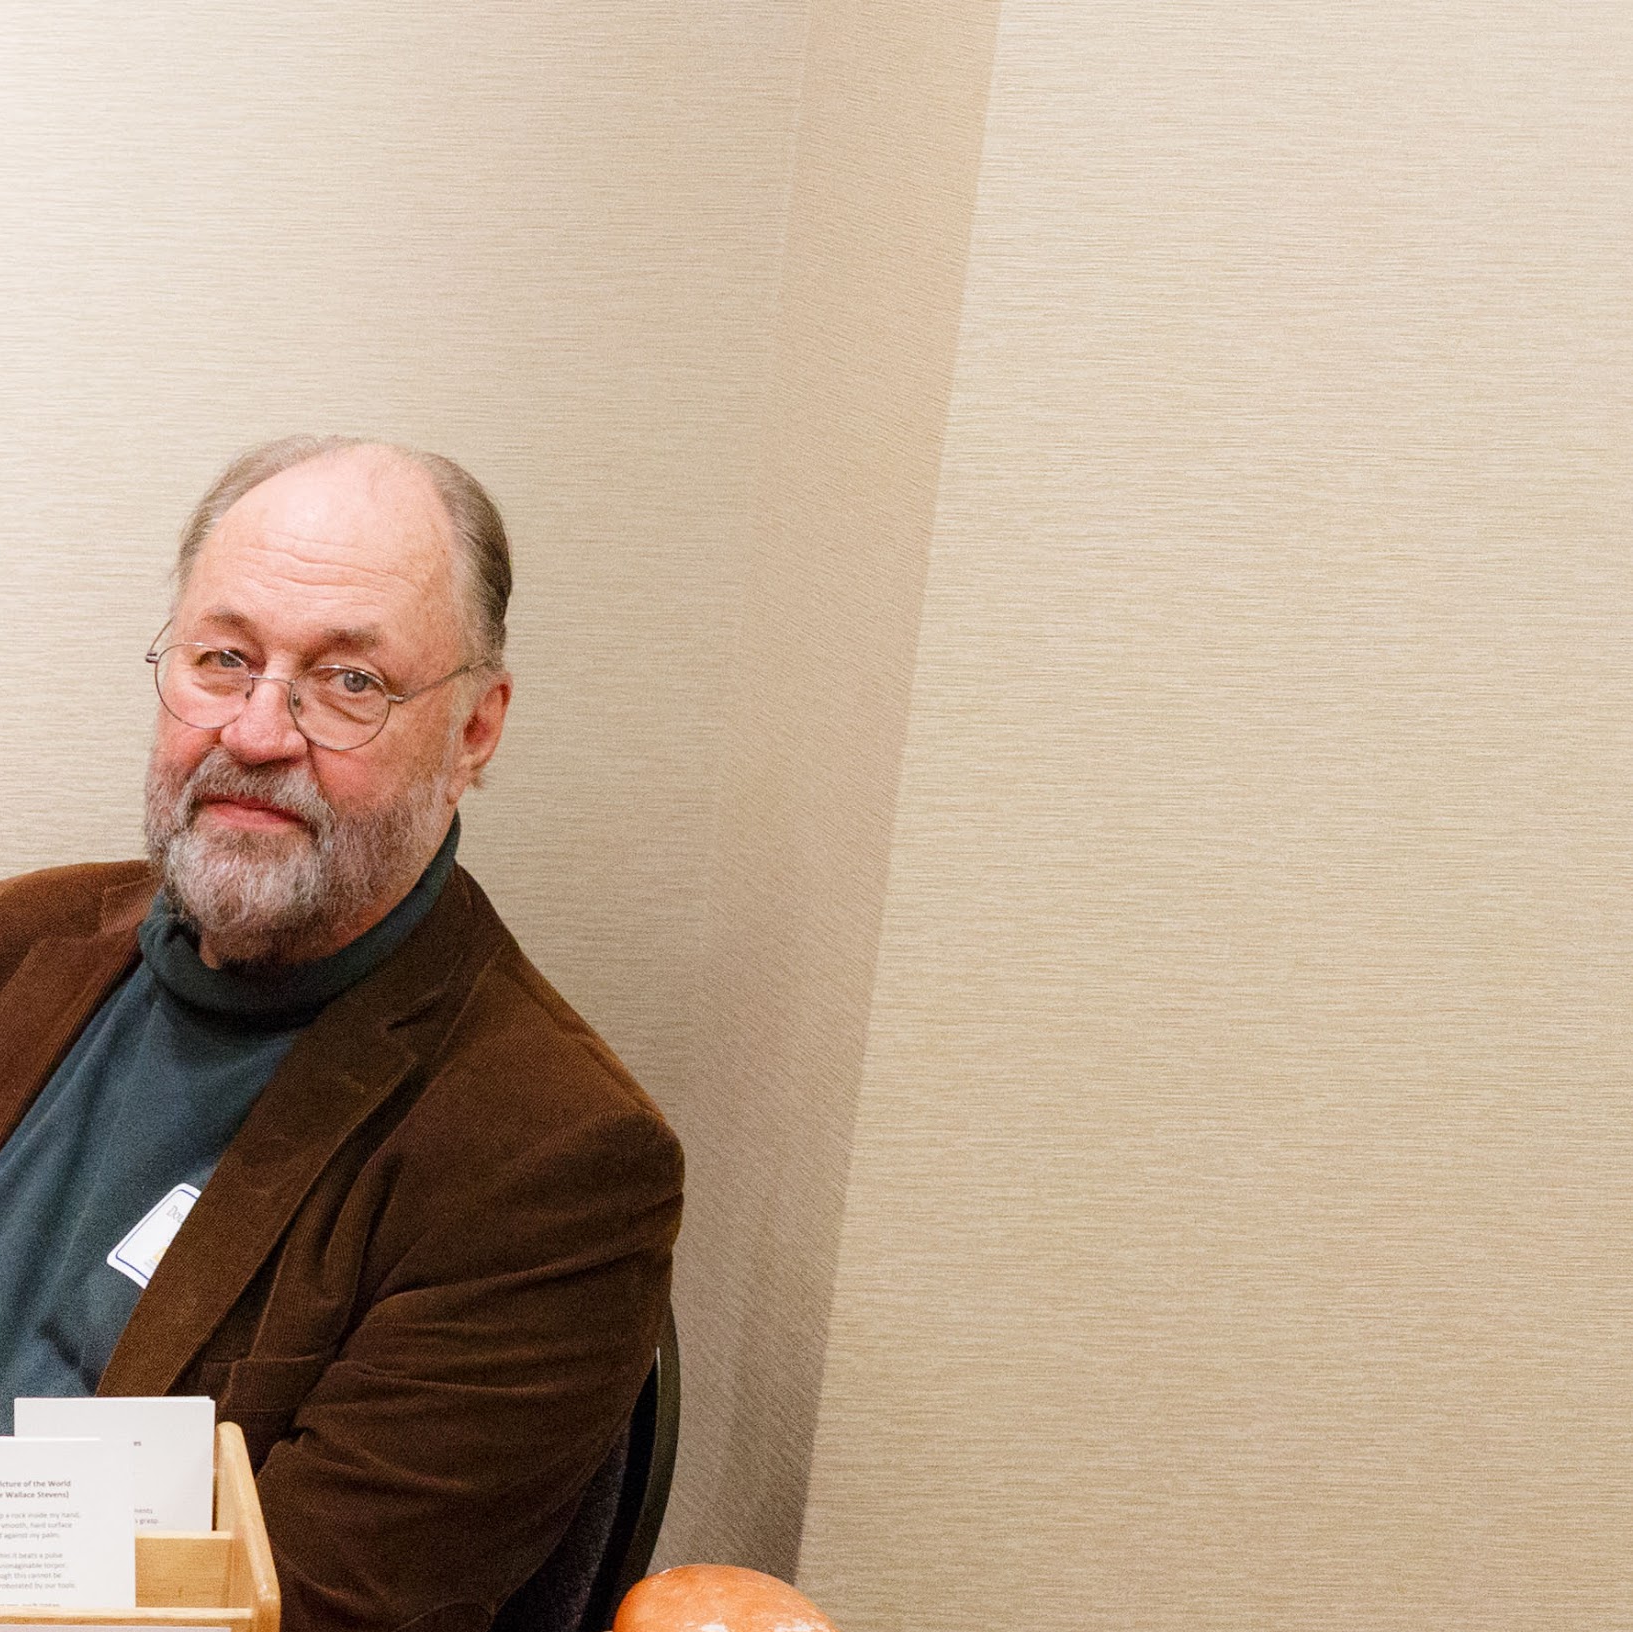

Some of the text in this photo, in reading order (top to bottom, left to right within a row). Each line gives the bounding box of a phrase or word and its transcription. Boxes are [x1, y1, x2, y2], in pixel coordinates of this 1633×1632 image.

[23, 1480, 32, 1488] of
[33, 1480, 46, 1488] the
[48, 1480, 71, 1488] World
[5, 1490, 35, 1498] Wallace
[37, 1490, 70, 1499] Stevens)
